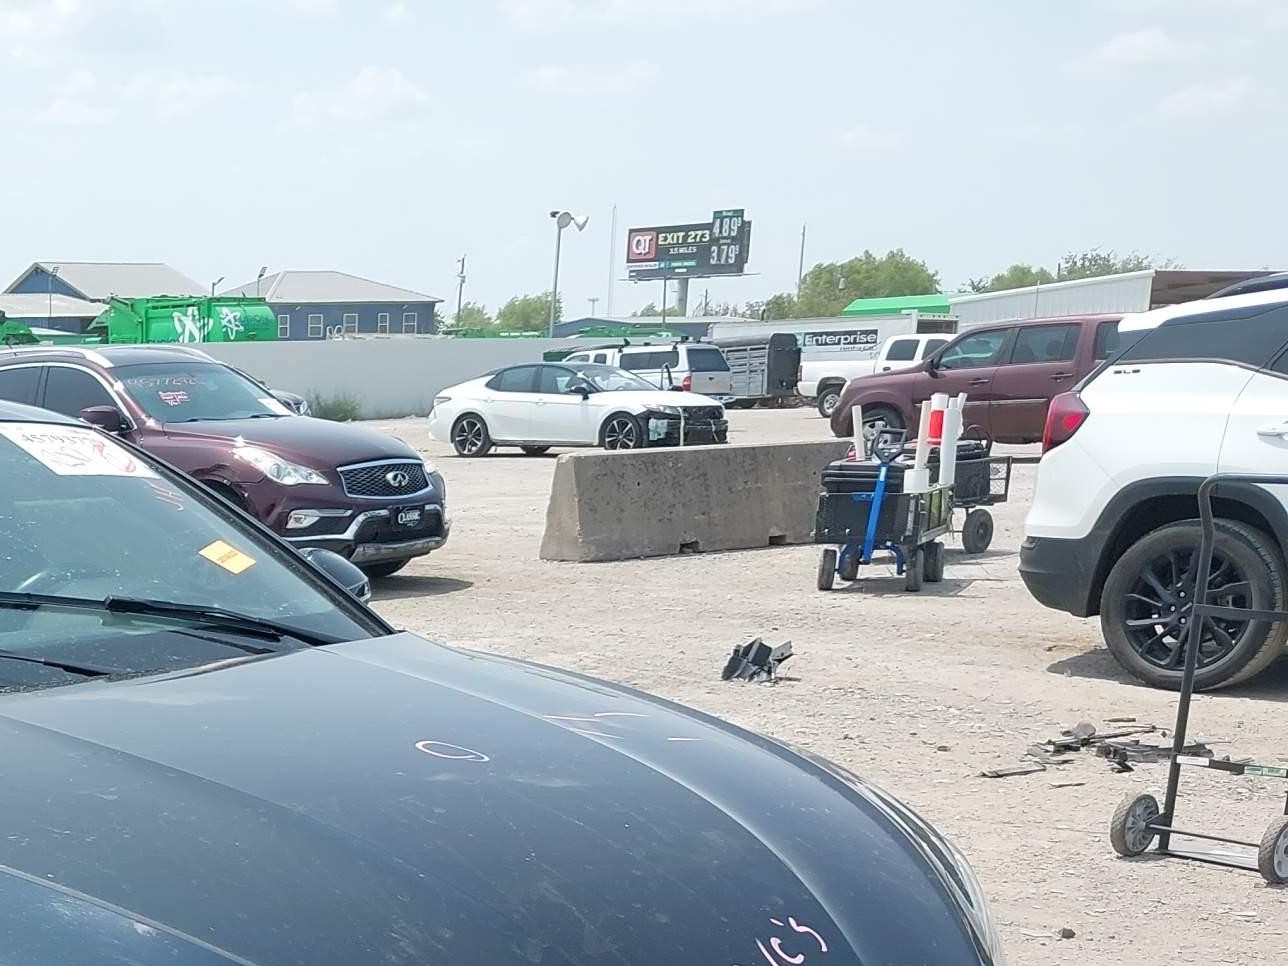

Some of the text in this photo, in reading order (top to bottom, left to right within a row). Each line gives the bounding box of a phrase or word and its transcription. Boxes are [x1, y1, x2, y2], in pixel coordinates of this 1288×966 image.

[658, 230, 710, 245] EXIT 273
[633, 235, 652, 256] QT
[804, 331, 877, 346] Enterprise
